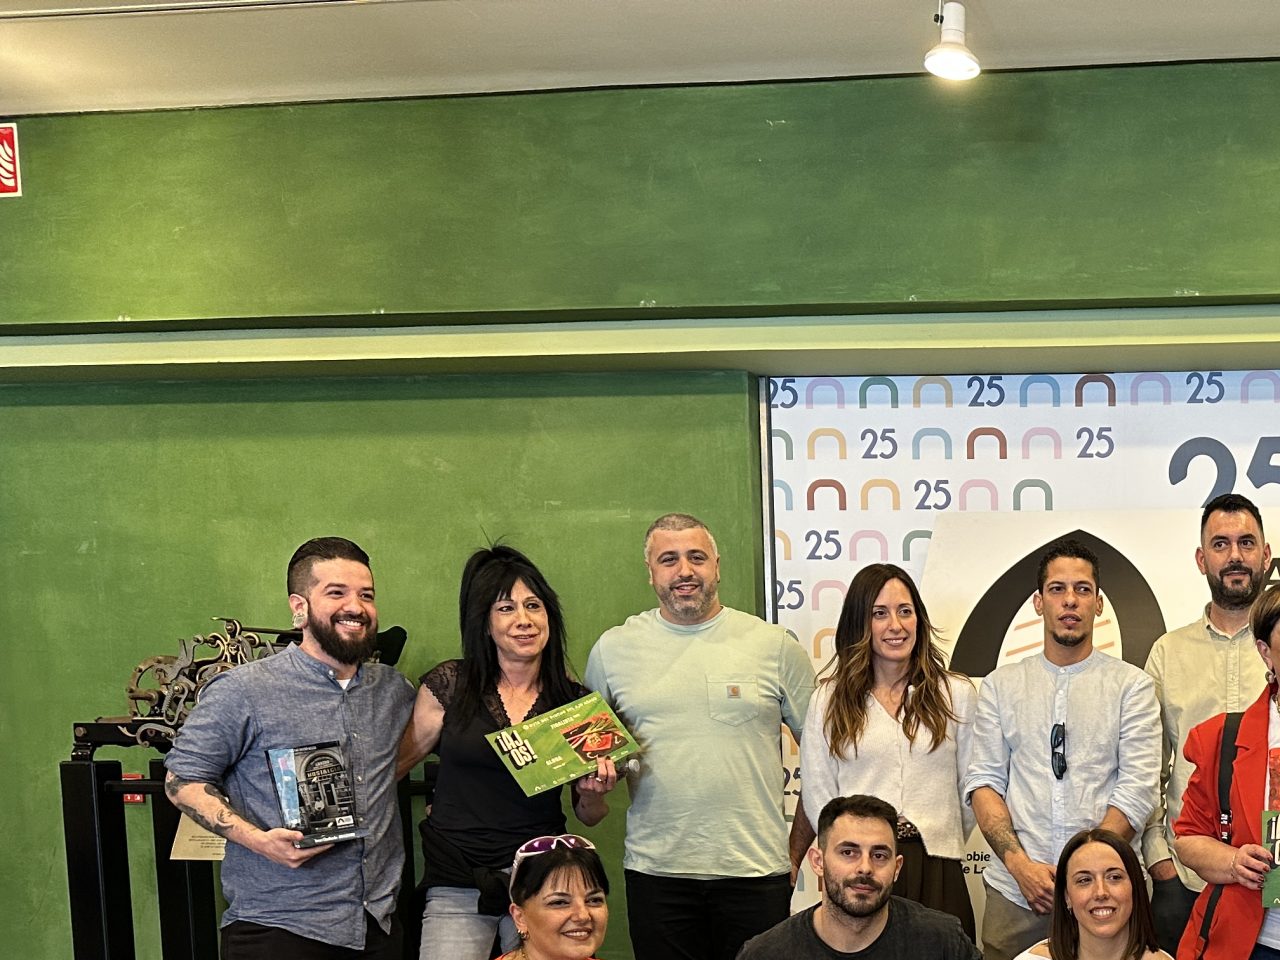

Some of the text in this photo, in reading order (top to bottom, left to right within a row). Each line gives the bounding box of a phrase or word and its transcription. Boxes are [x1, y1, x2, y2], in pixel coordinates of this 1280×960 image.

[967, 376, 1004, 407] 25
[1185, 372, 1224, 404] 25
[861, 429, 898, 459] 25
[1076, 427, 1114, 458] 25
[914, 480, 951, 510] 25
[805, 530, 841, 560] 25
[497, 729, 523, 752] ¡AJ
[510, 739, 538, 767] OS!
[963, 866, 971, 874] e
[966, 851, 991, 861] obie
